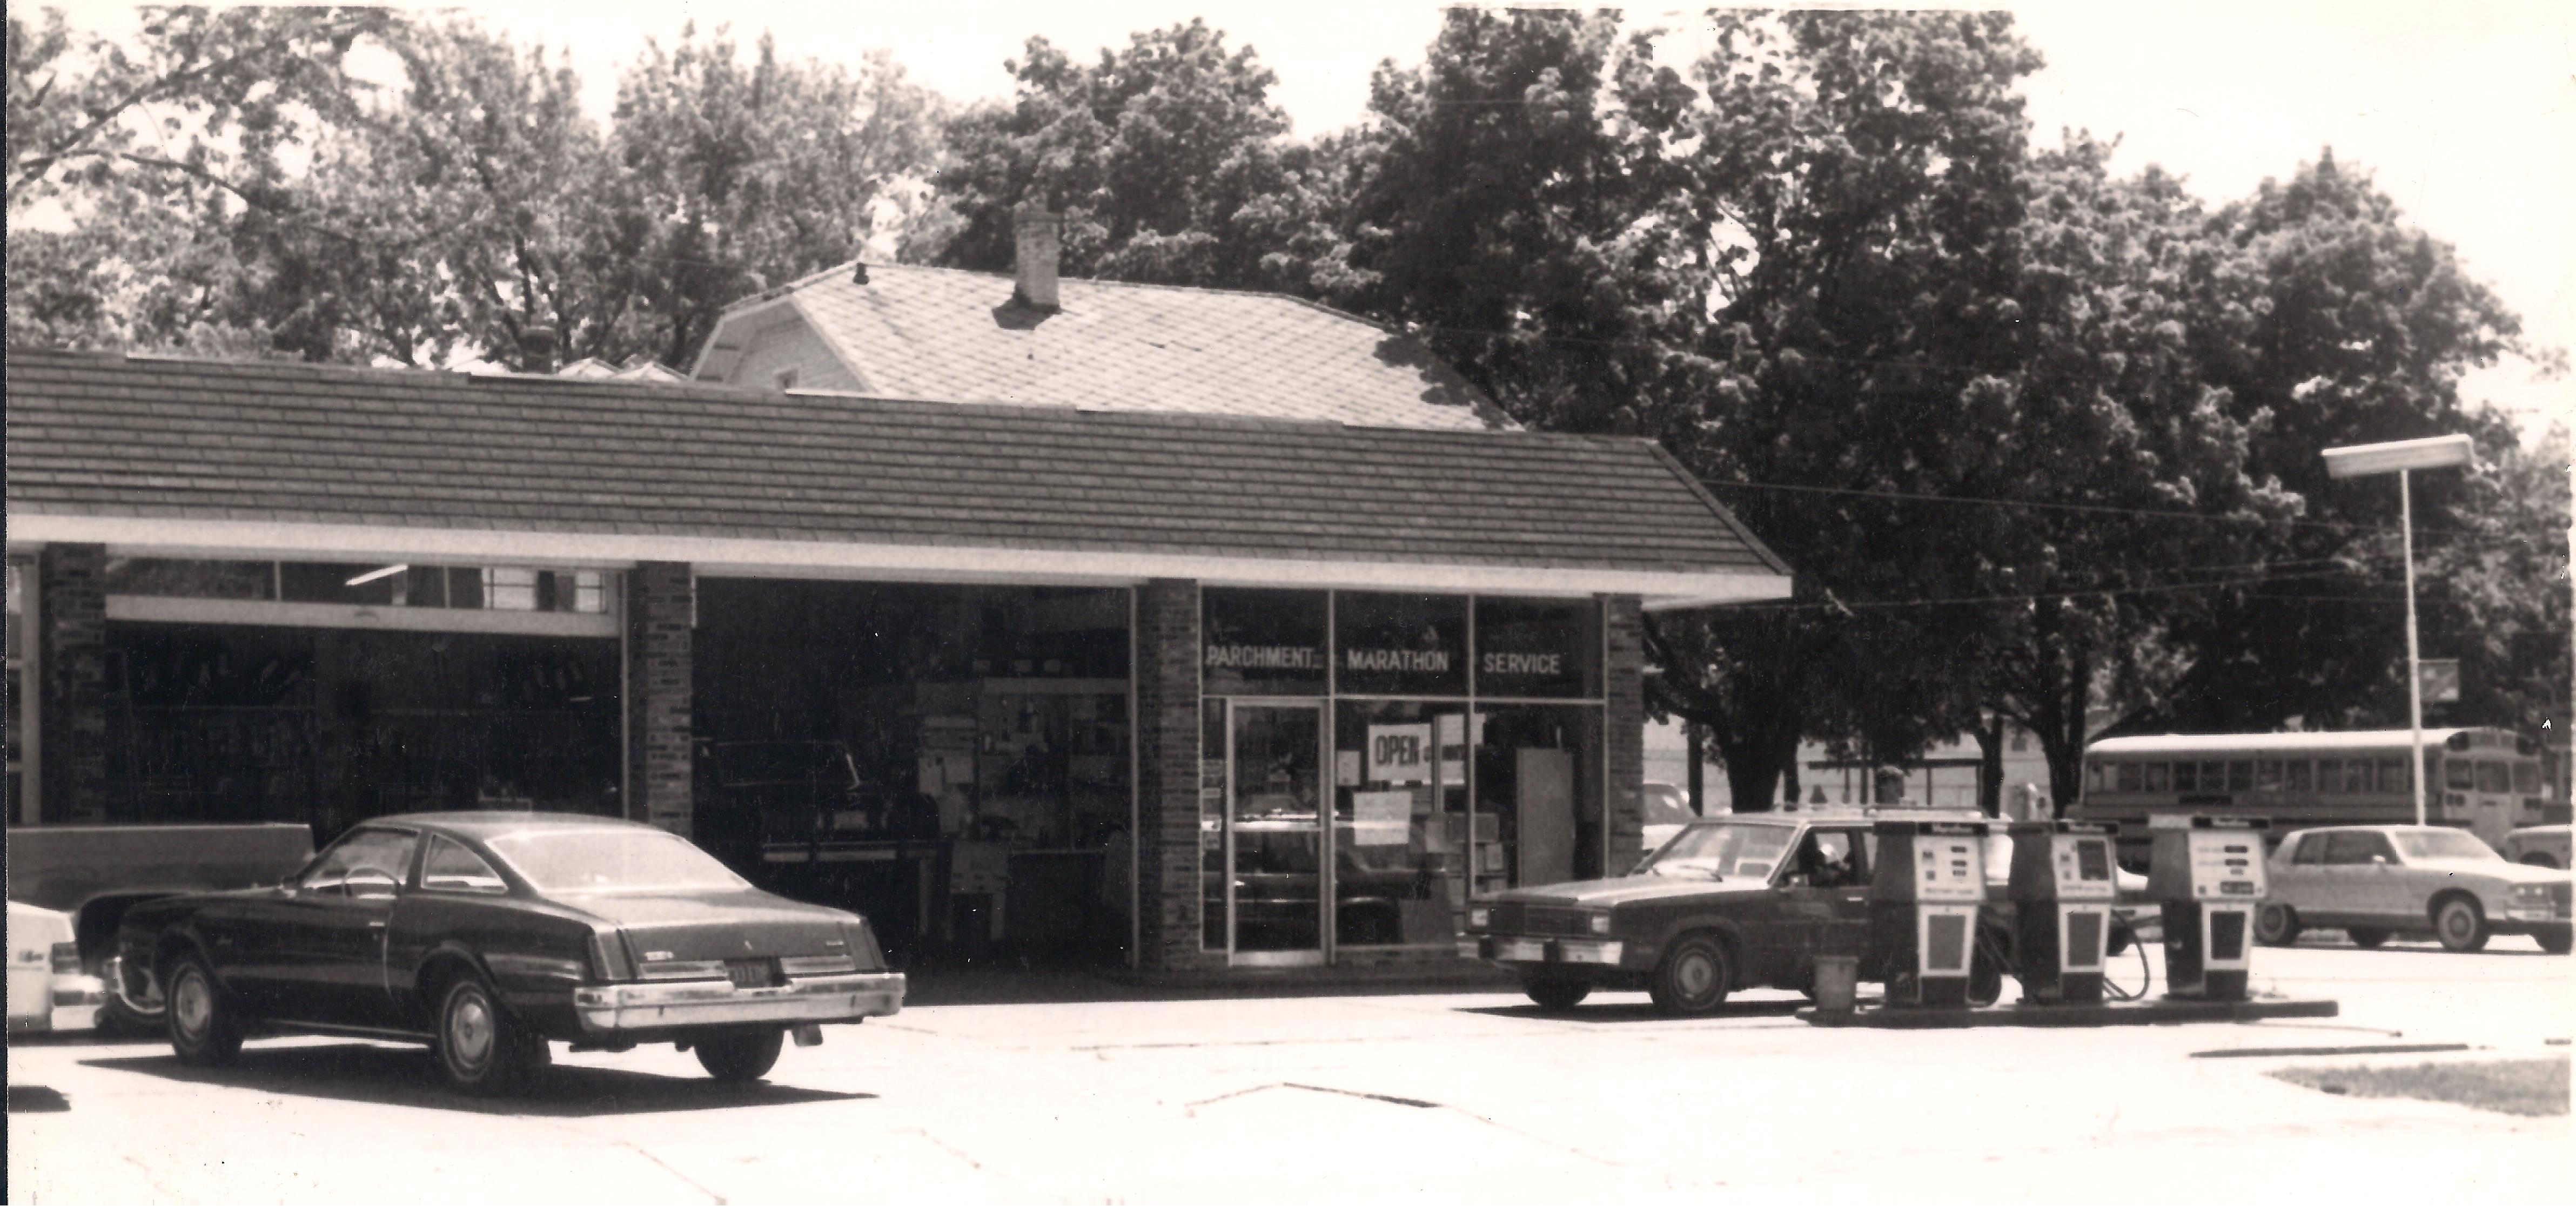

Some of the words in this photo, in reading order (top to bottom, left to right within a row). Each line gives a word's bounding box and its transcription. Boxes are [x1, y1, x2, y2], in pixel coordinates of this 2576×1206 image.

[1205, 645, 1313, 669] PARCHMENT
[1347, 649, 1448, 671] MARATHON
[1484, 652, 1561, 675] SERVICE
[1376, 735, 1420, 766] OPEN
